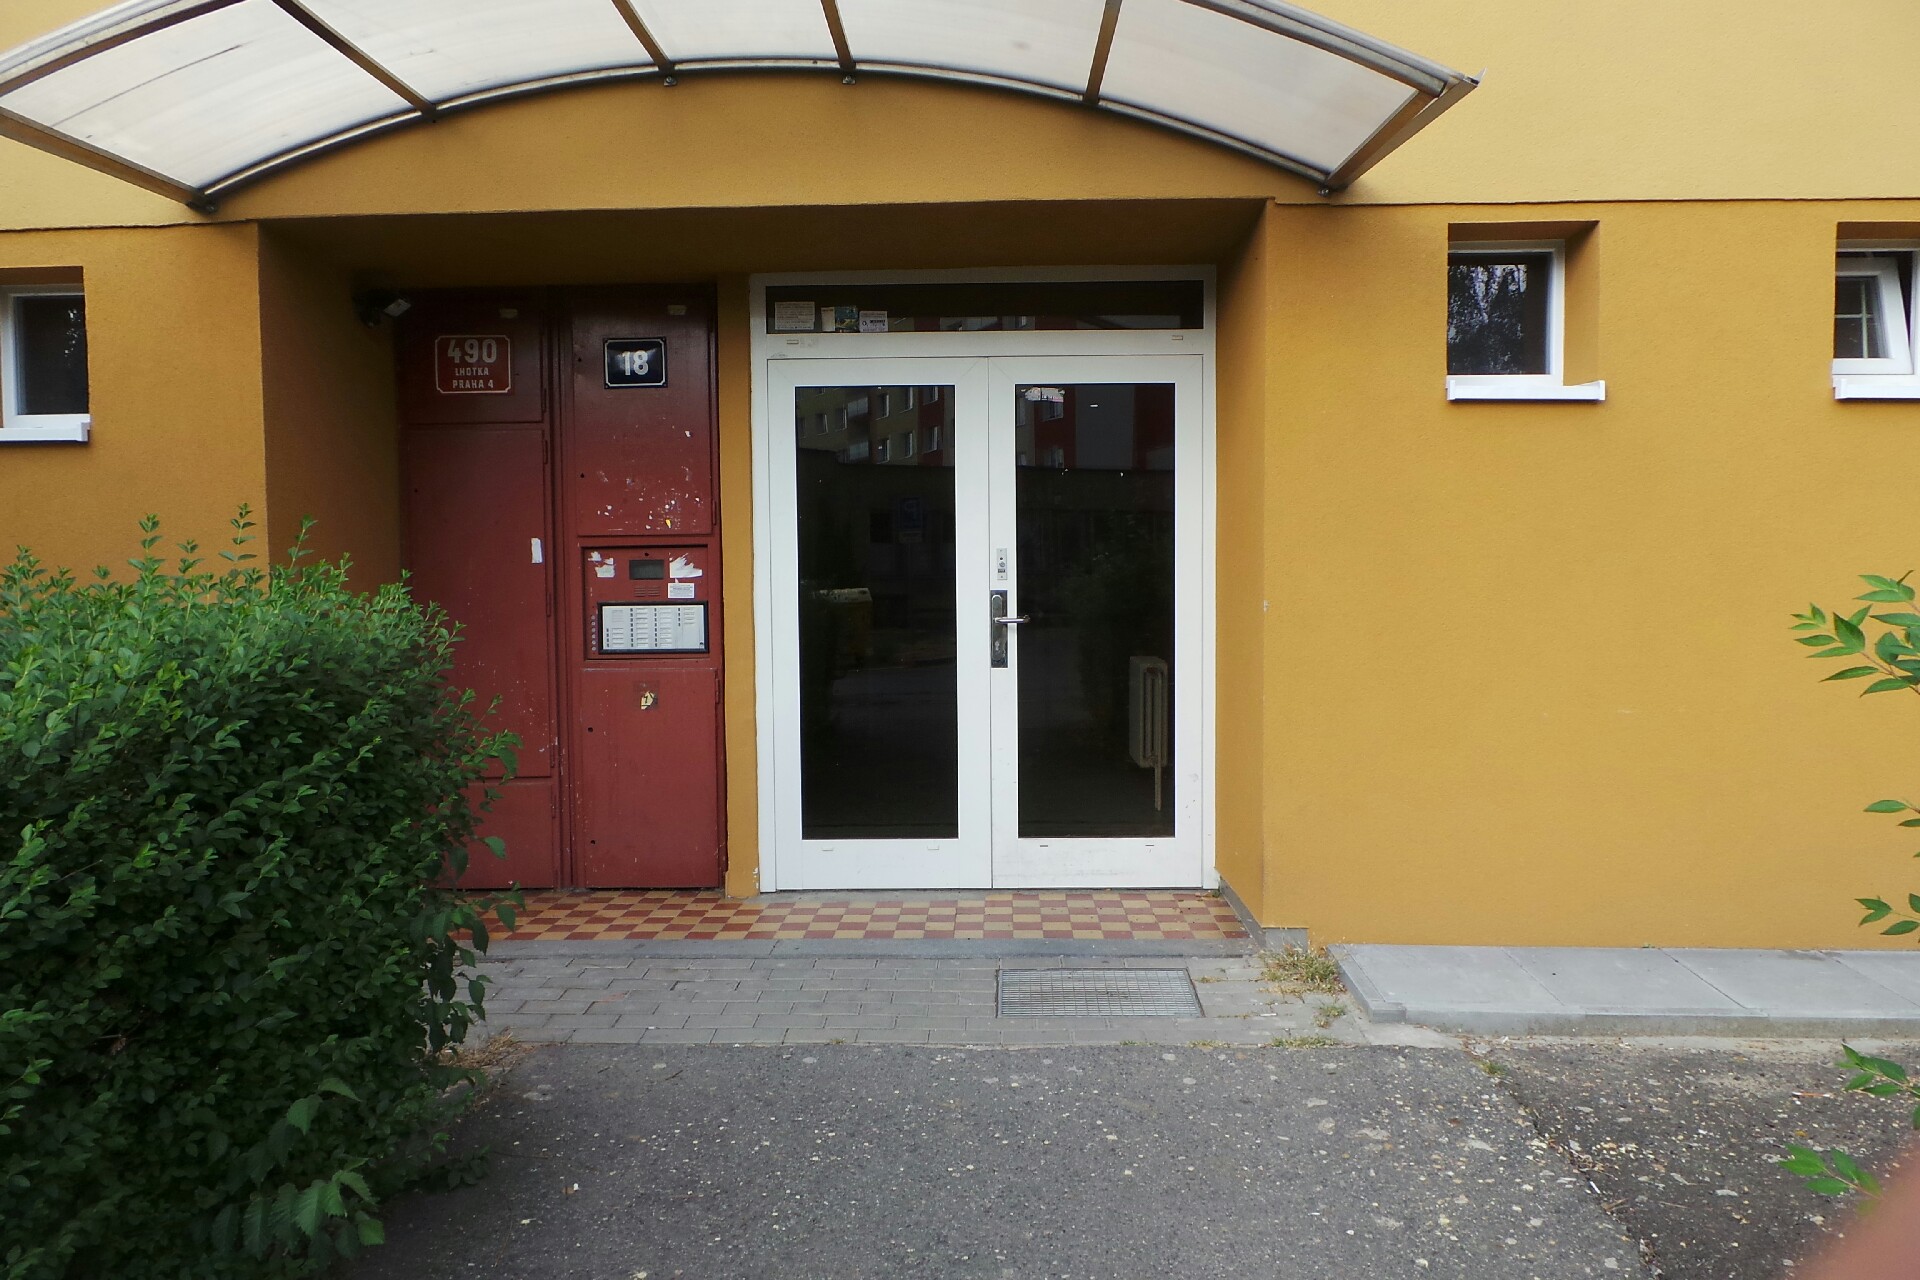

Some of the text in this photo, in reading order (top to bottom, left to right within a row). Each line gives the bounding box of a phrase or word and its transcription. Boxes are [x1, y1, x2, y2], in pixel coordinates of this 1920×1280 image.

[447, 338, 497, 364] 490
[455, 367, 489, 376] LHOTKA
[622, 349, 649, 376] 18
[452, 379, 494, 389] PRAHA 4
